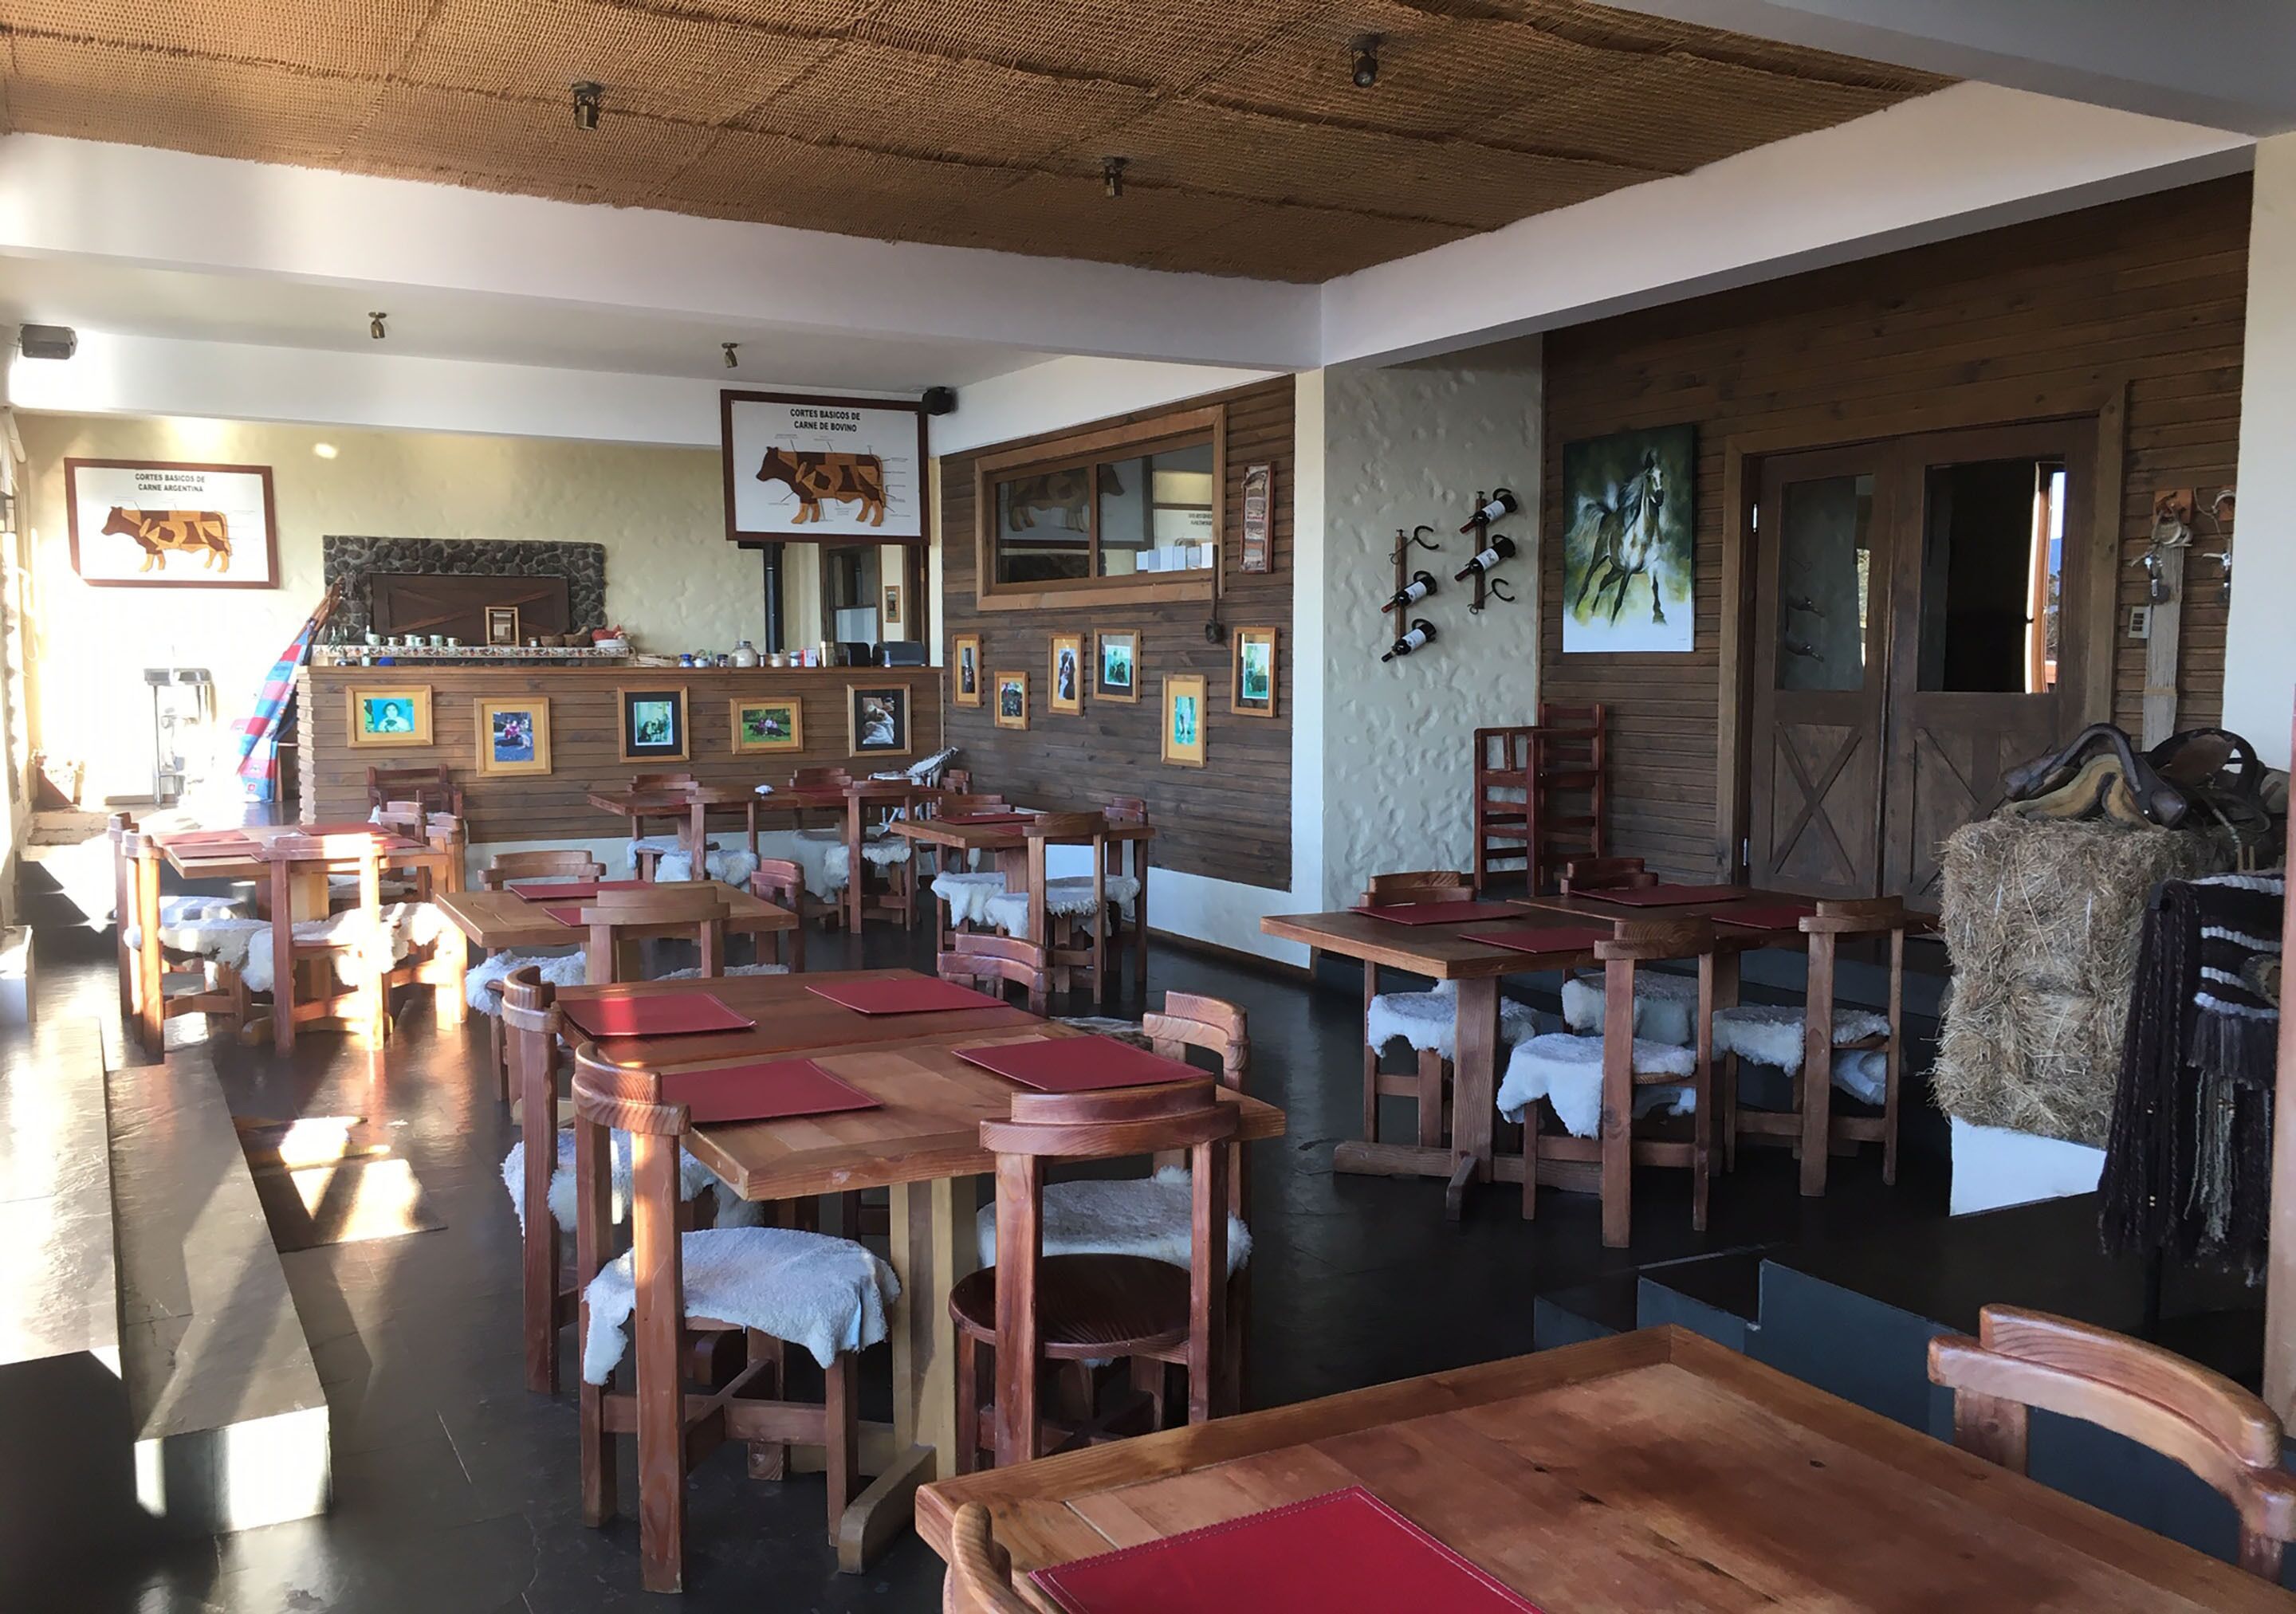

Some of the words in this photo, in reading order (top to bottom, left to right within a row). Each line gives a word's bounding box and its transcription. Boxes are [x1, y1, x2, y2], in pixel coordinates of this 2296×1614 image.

[790, 408, 818, 418] CORTES
[820, 410, 850, 419] BASICOS
[851, 412, 860, 421] DE
[794, 421, 818, 430] CARNE
[820, 422, 828, 430] DE
[831, 422, 857, 432] BOVINO
